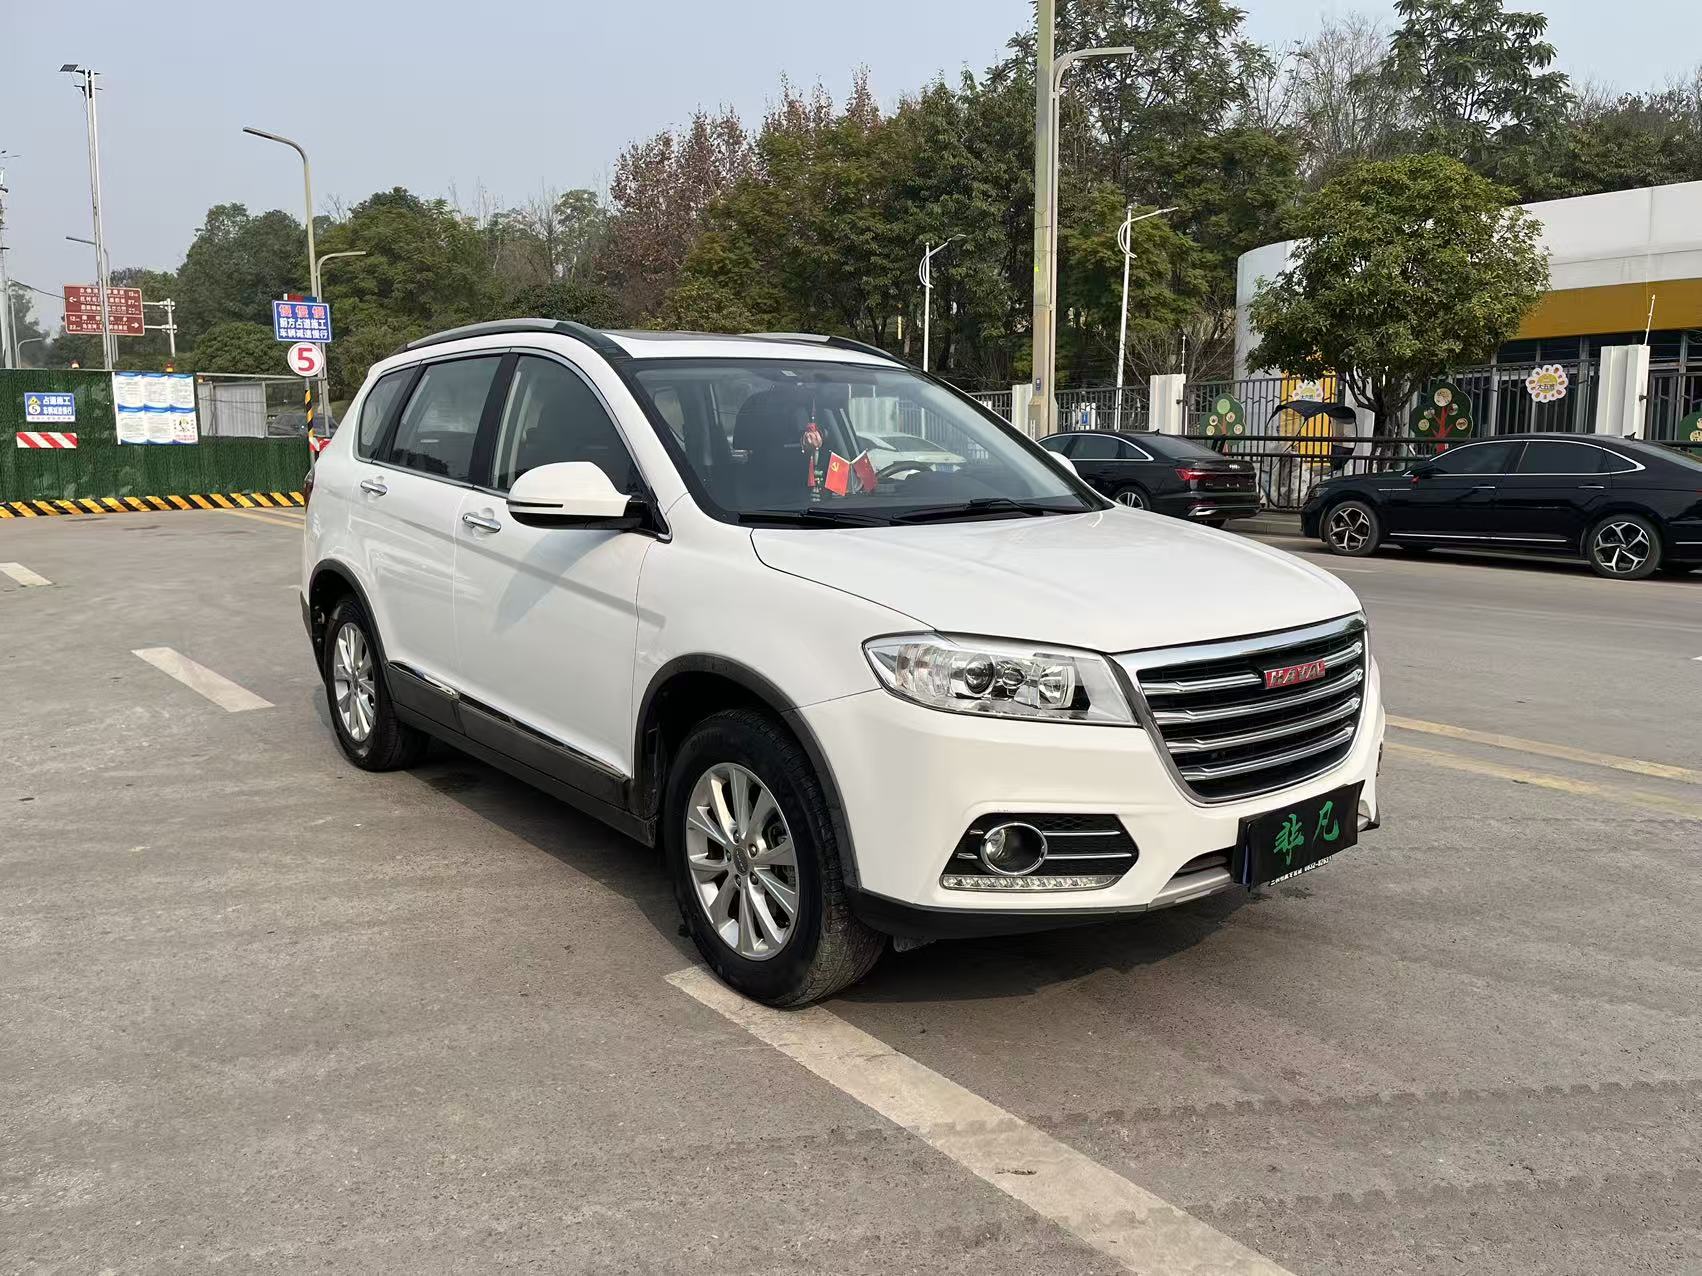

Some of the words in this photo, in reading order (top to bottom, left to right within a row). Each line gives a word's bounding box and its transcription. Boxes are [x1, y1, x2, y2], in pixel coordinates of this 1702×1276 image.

[279, 317, 327, 329] 前方占道施工
[279, 328, 328, 339] 车辆减速慢行
[298, 347, 315, 372] 5
